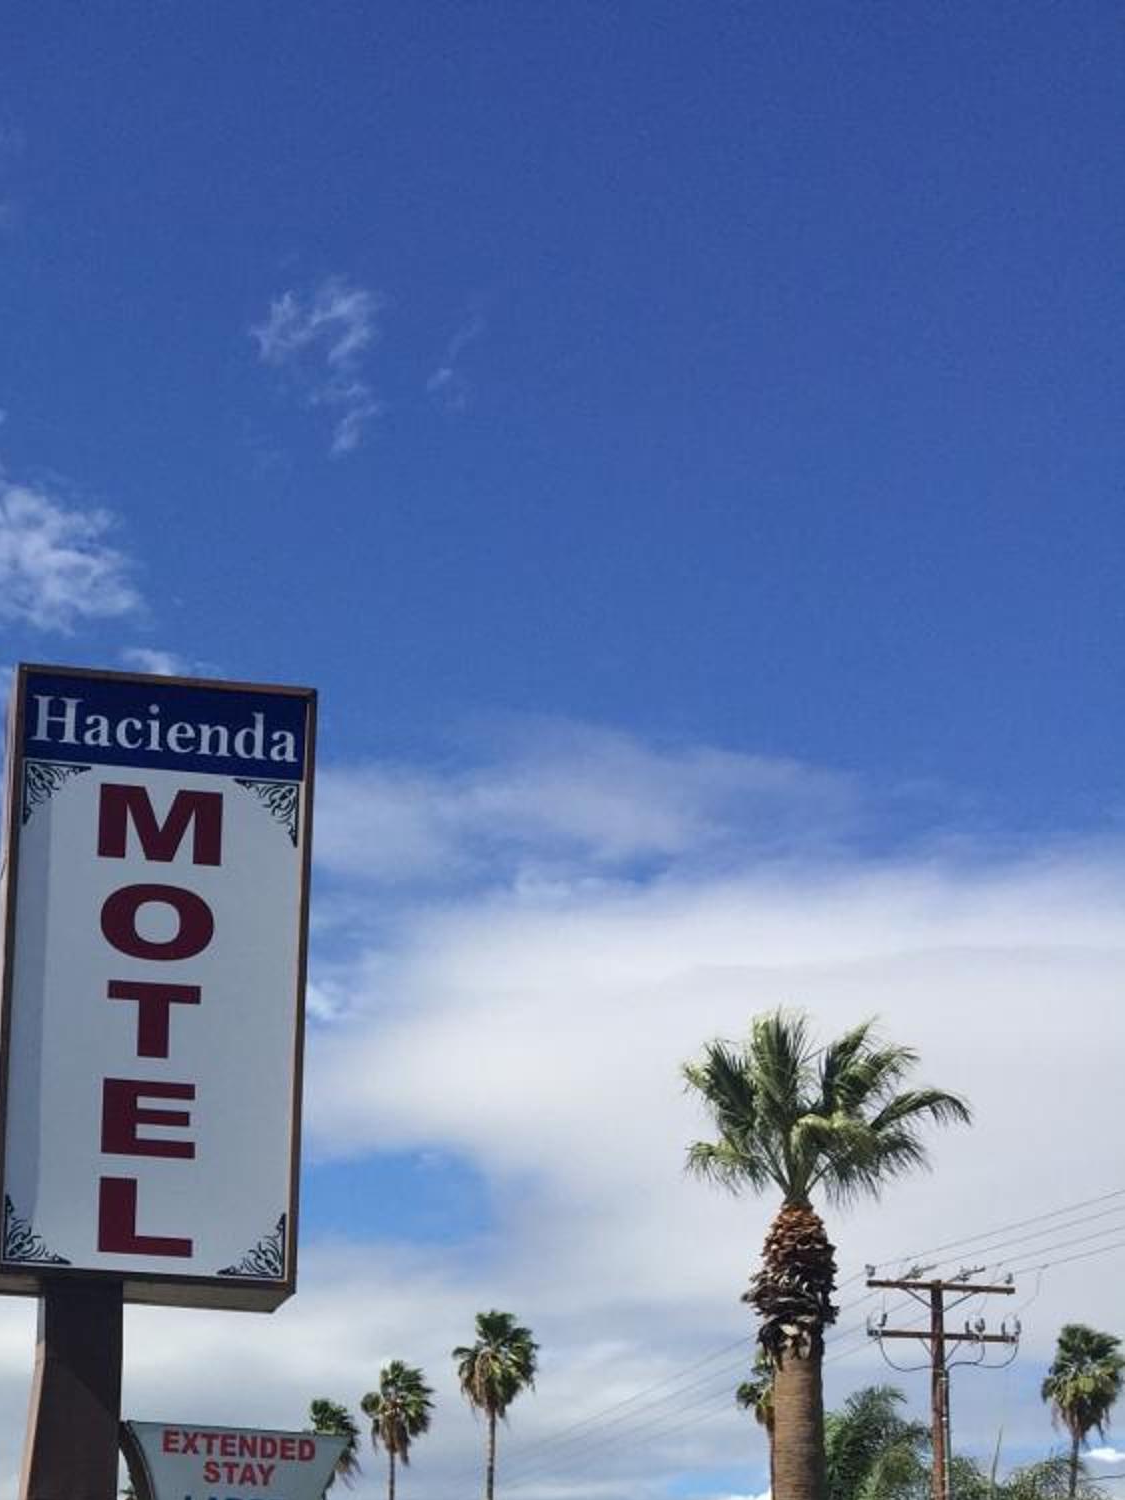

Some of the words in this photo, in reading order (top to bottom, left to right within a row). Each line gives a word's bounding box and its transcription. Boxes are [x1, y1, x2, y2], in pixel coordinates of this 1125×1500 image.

[32, 693, 298, 764] Hacienda
[96, 782, 225, 1259] MOTEL
[162, 1430, 316, 1462] EXTENDED
[203, 1461, 276, 1486] STAY
